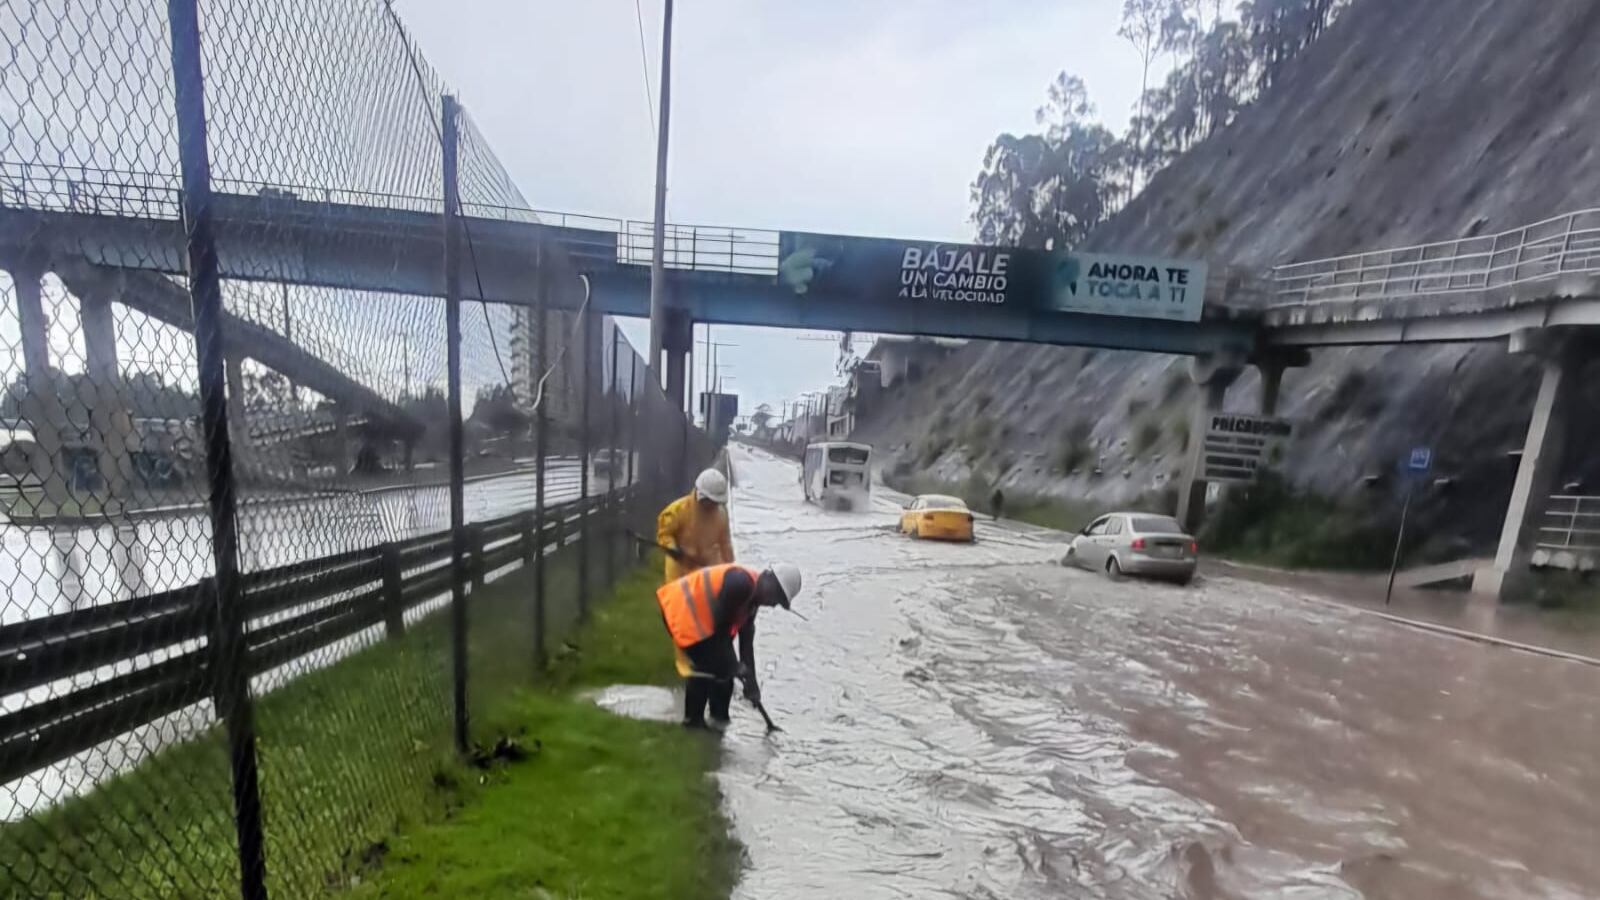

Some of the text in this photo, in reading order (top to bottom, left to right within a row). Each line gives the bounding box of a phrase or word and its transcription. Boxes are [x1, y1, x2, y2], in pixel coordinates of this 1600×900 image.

[901, 270, 1008, 291] UN CAMBIO
[1088, 262, 1190, 285] AHORA TE
[898, 285, 1006, 304] A LA VELOCIDAD
[1087, 280, 1186, 303] TOCA A TI
